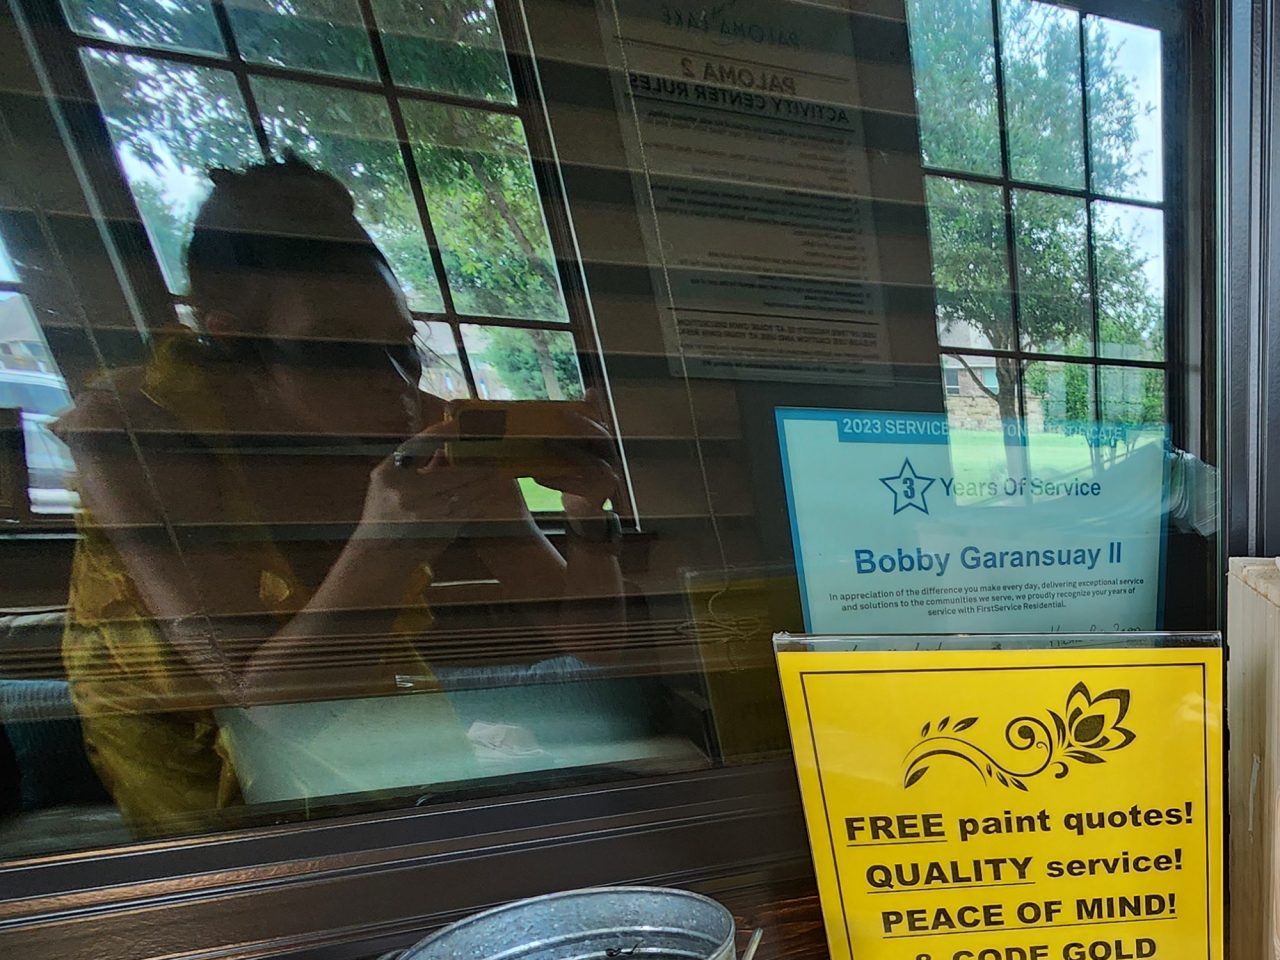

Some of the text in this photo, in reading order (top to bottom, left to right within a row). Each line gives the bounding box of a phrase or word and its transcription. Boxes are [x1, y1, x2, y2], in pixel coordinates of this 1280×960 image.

[843, 419, 881, 434] 2023
[885, 420, 949, 436] SERVICE
[902, 476, 1101, 499] 3 Years Of Service
[855, 548, 950, 577] Bobby
[960, 545, 1101, 572] Garansuay
[840, 590, 893, 602] appreciation
[896, 589, 904, 597] of
[906, 588, 919, 596] the
[921, 586, 962, 595] difference
[964, 586, 978, 595] you
[979, 583, 1001, 592] make
[1002, 584, 1022, 593] every
[1024, 583, 1040, 591] day,
[1042, 580, 1077, 590] delivering
[1078, 577, 1118, 588] exceptional
[1119, 577, 1144, 586] service
[842, 604, 858, 612] and
[859, 601, 899, 611] solutions
[926, 597, 977, 606] communities
[1028, 592, 1056, 601] proudly
[1057, 590, 1090, 599] recognize
[1092, 589, 1106, 598] your
[1107, 588, 1127, 597] years
[928, 600, 1066, 616] service with FirstService Residential.
[845, 801, 1193, 842] FREE paint quotes!
[865, 848, 1183, 889] QUALITY service!
[881, 893, 1177, 934] PEACE OF MIND!
